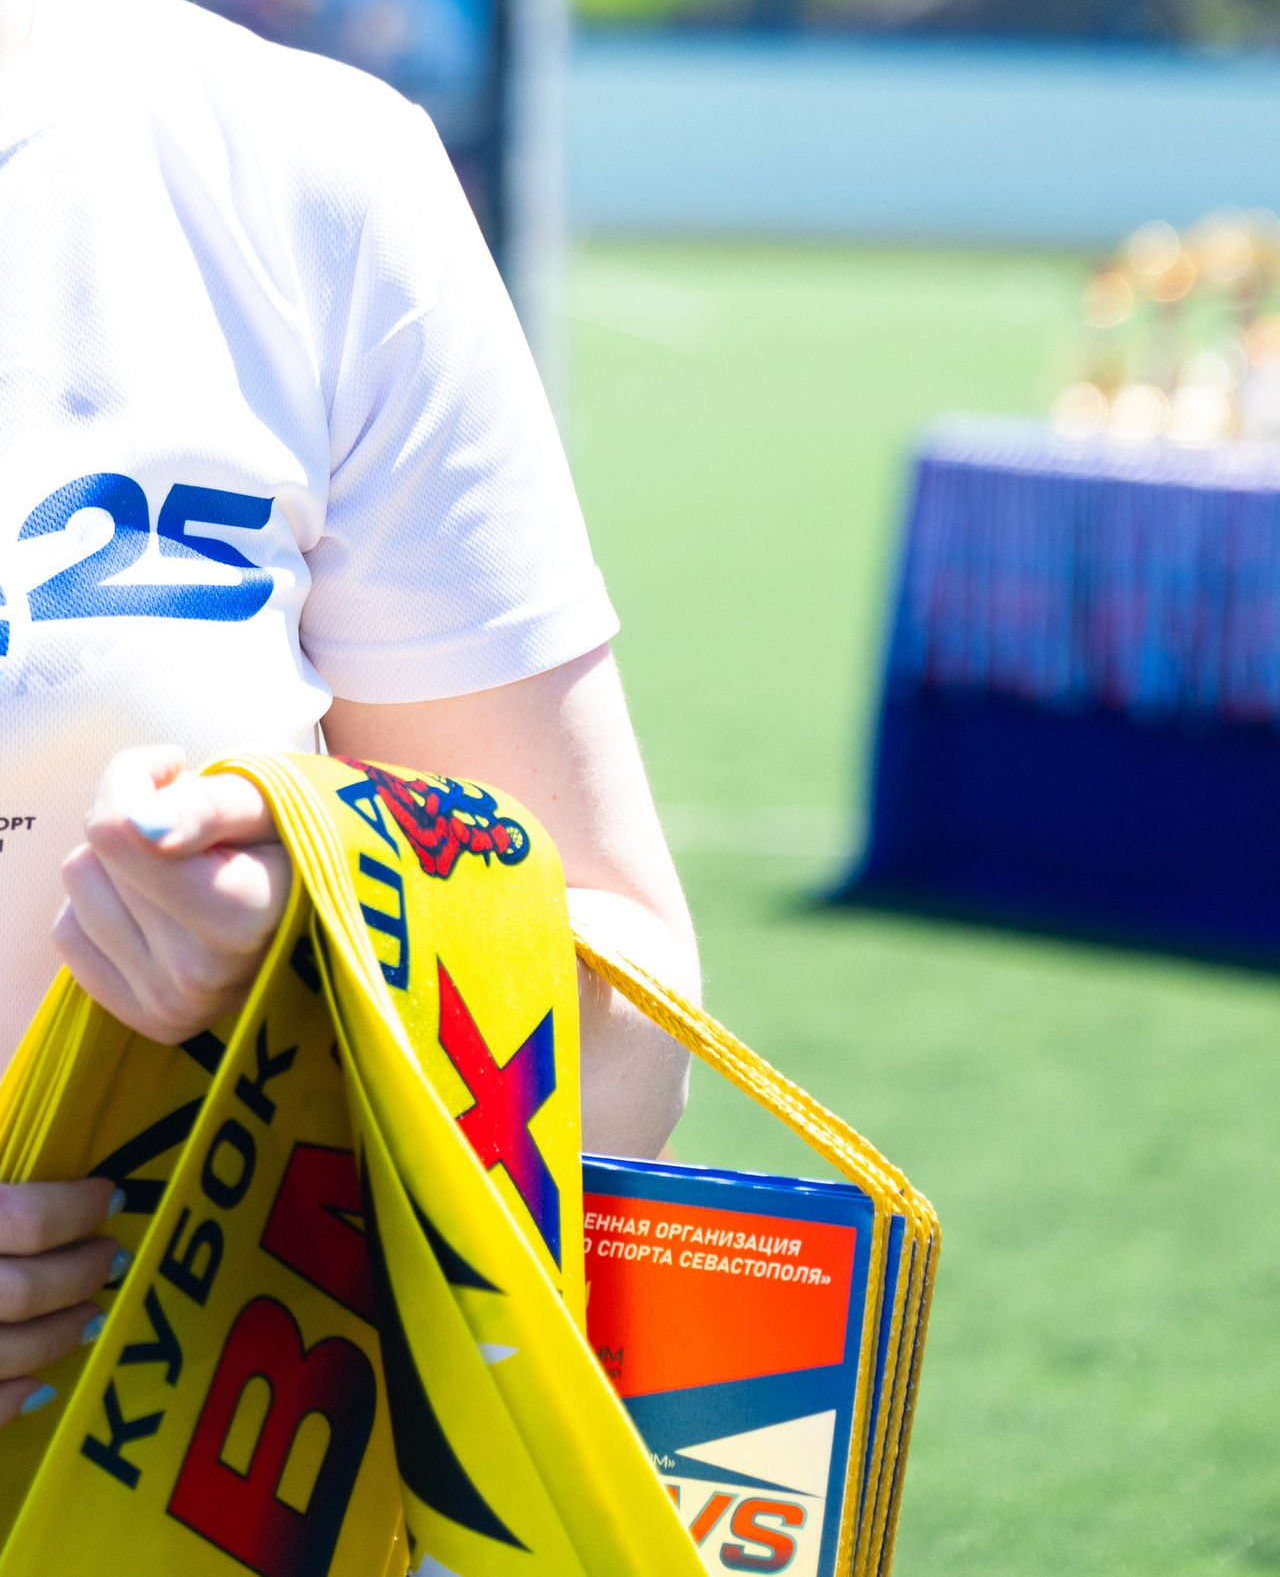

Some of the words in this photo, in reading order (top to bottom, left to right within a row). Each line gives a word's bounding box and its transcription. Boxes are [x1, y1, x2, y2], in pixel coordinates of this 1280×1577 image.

[79, 1015, 300, 1491] КУБОК
[583, 1211, 652, 1237] ЕННАЯ
[655, 1222, 803, 1258] ОРГАНИЗАЦИЯ
[597, 1240, 673, 1266] СПОРТА
[679, 1251, 832, 1286] СЕВАСТОПОЛЯ»
